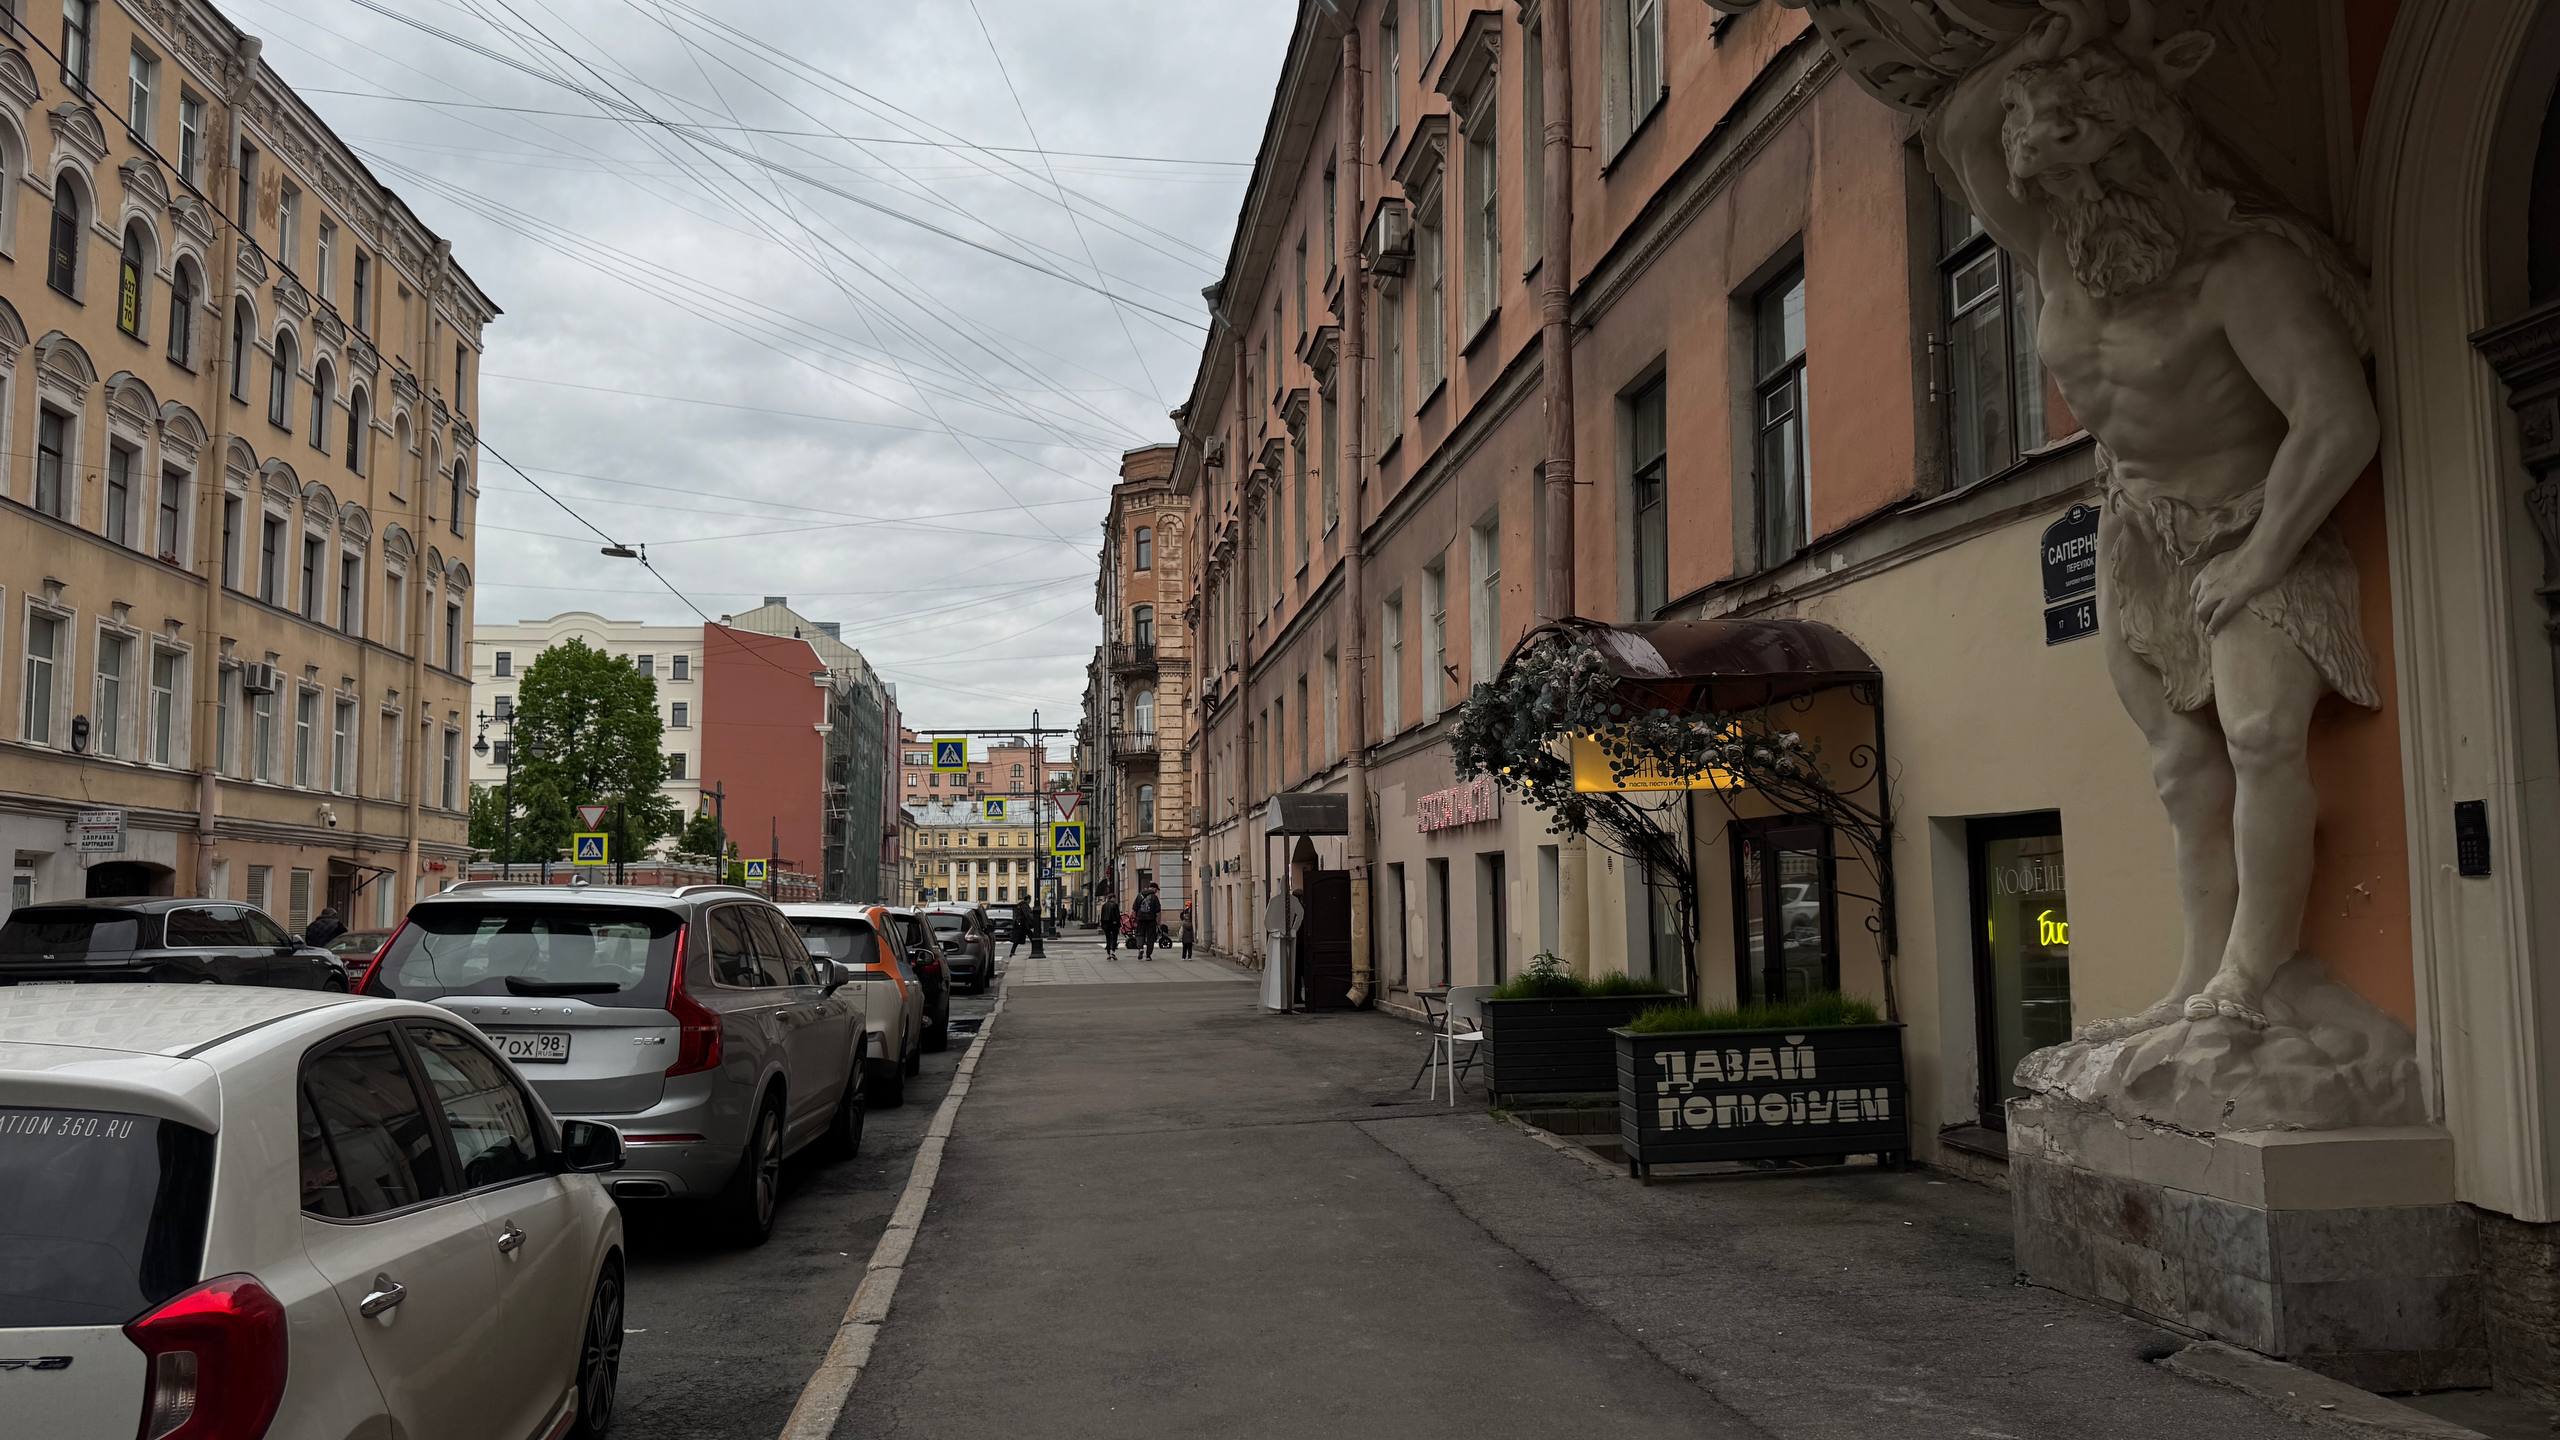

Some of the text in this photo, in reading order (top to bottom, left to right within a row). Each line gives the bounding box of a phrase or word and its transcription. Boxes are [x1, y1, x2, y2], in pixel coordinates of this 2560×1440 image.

[125, 307, 133, 322] 70
[2066, 556, 2095, 574] ПЕРЕУЛОК
[2077, 606, 2091, 629] 15
[540, 1036, 561, 1051] 98
[1654, 1035, 1817, 1095] ДАВАЙ
[1658, 1087, 1890, 1131] ПОПРОБУЕМ
[57, 1117, 133, 1139] 360.RU
